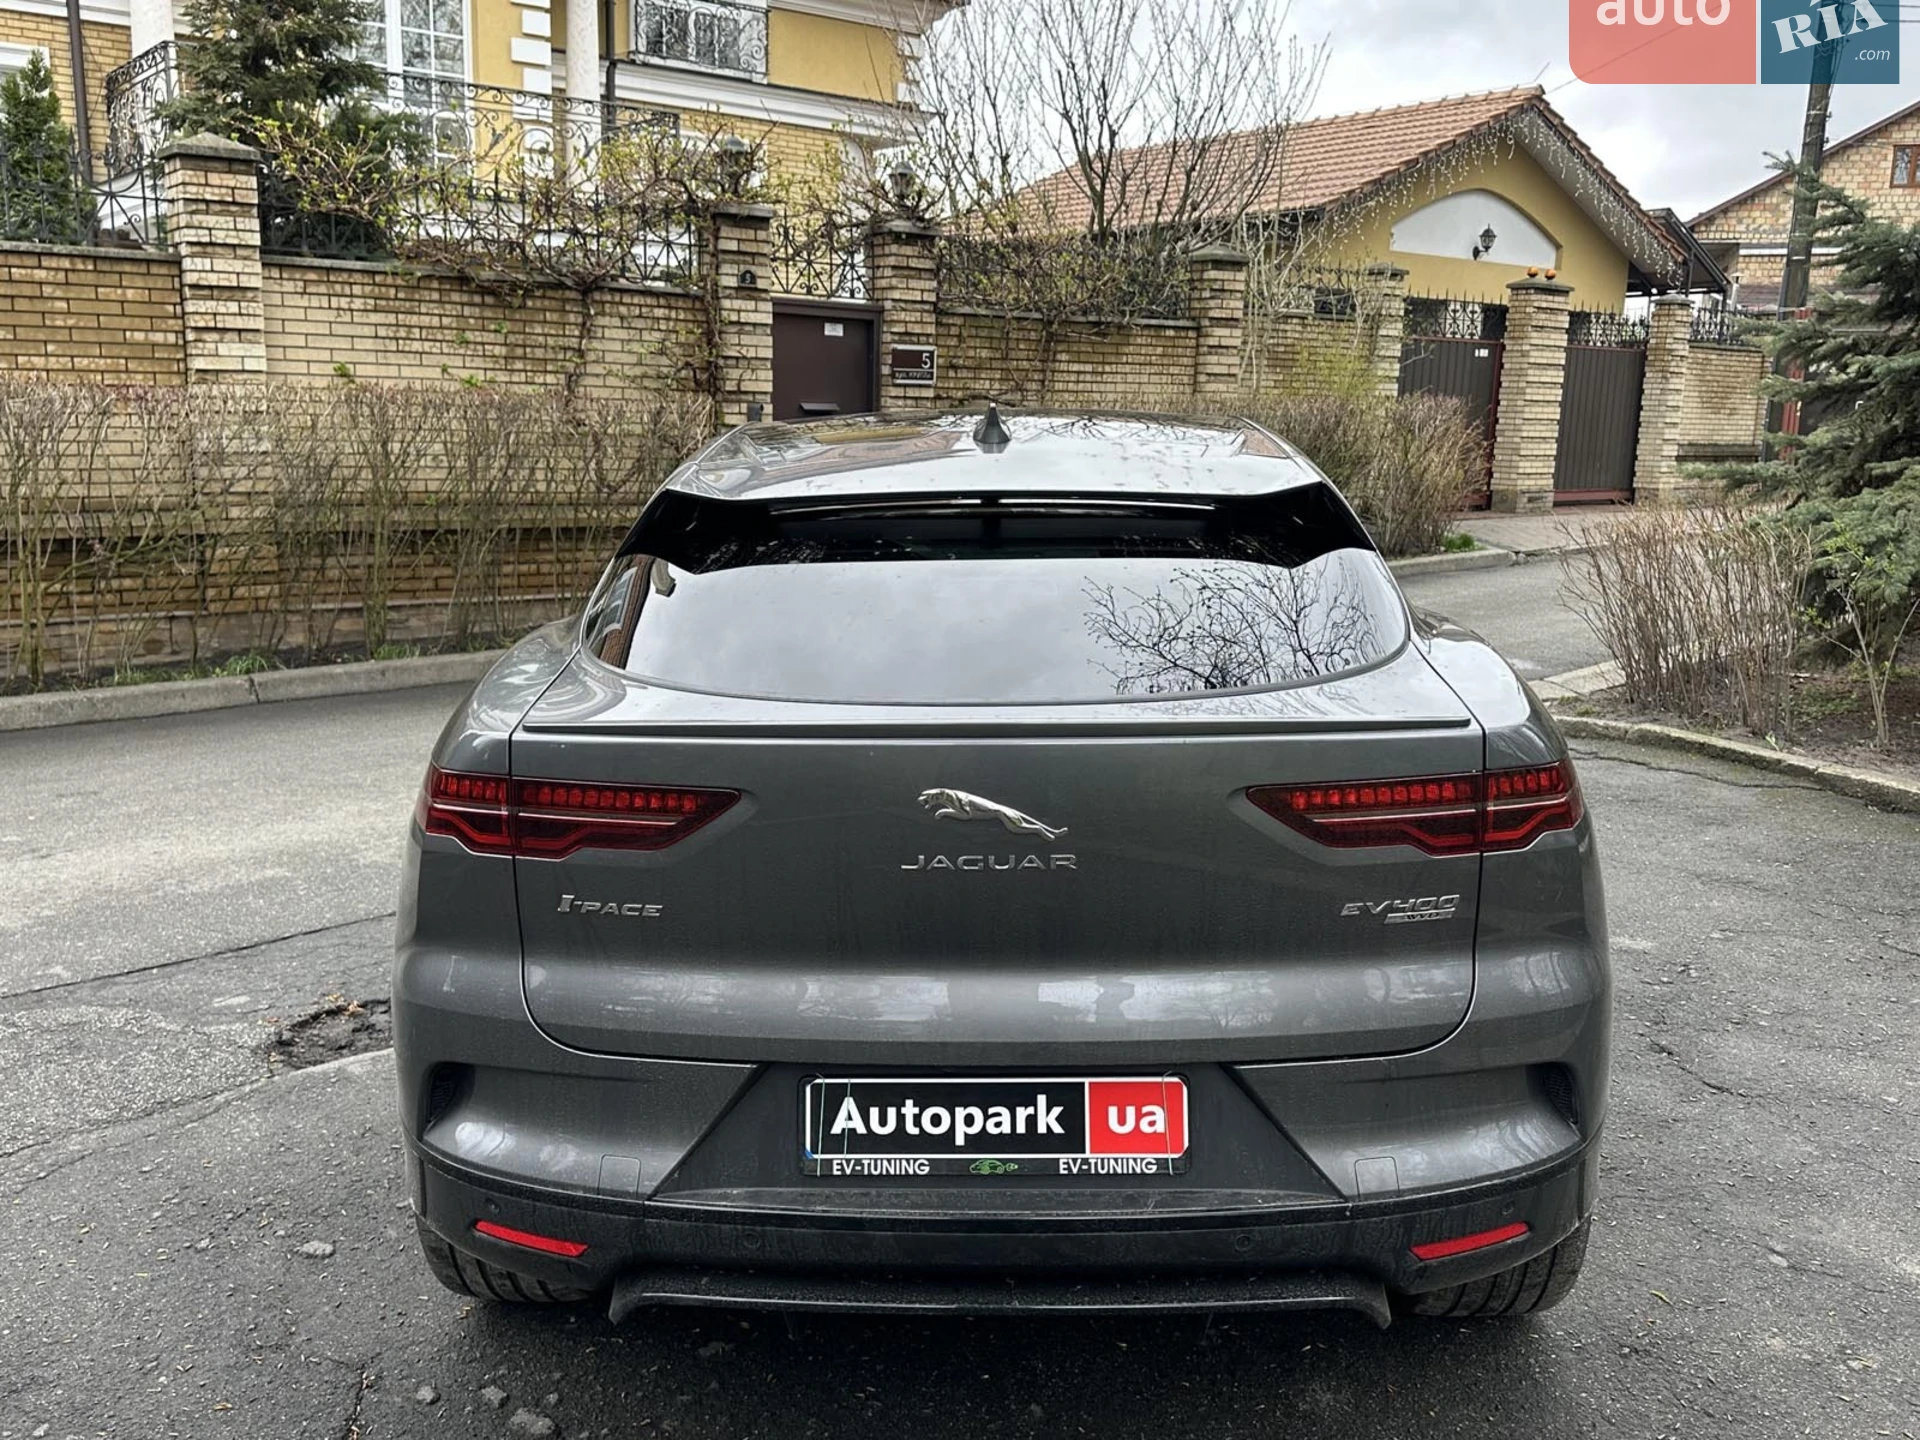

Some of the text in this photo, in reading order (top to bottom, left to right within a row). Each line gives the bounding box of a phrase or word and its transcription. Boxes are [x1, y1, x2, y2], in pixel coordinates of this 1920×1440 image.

[921, 352, 931, 369] 5
[900, 854, 1078, 871] JAGUAR
[557, 894, 663, 917] I-PACE
[1340, 894, 1460, 916] EV400
[830, 1094, 1166, 1146] Autopark ua
[832, 1157, 1158, 1176] EV-TUNING EV-TUNING
